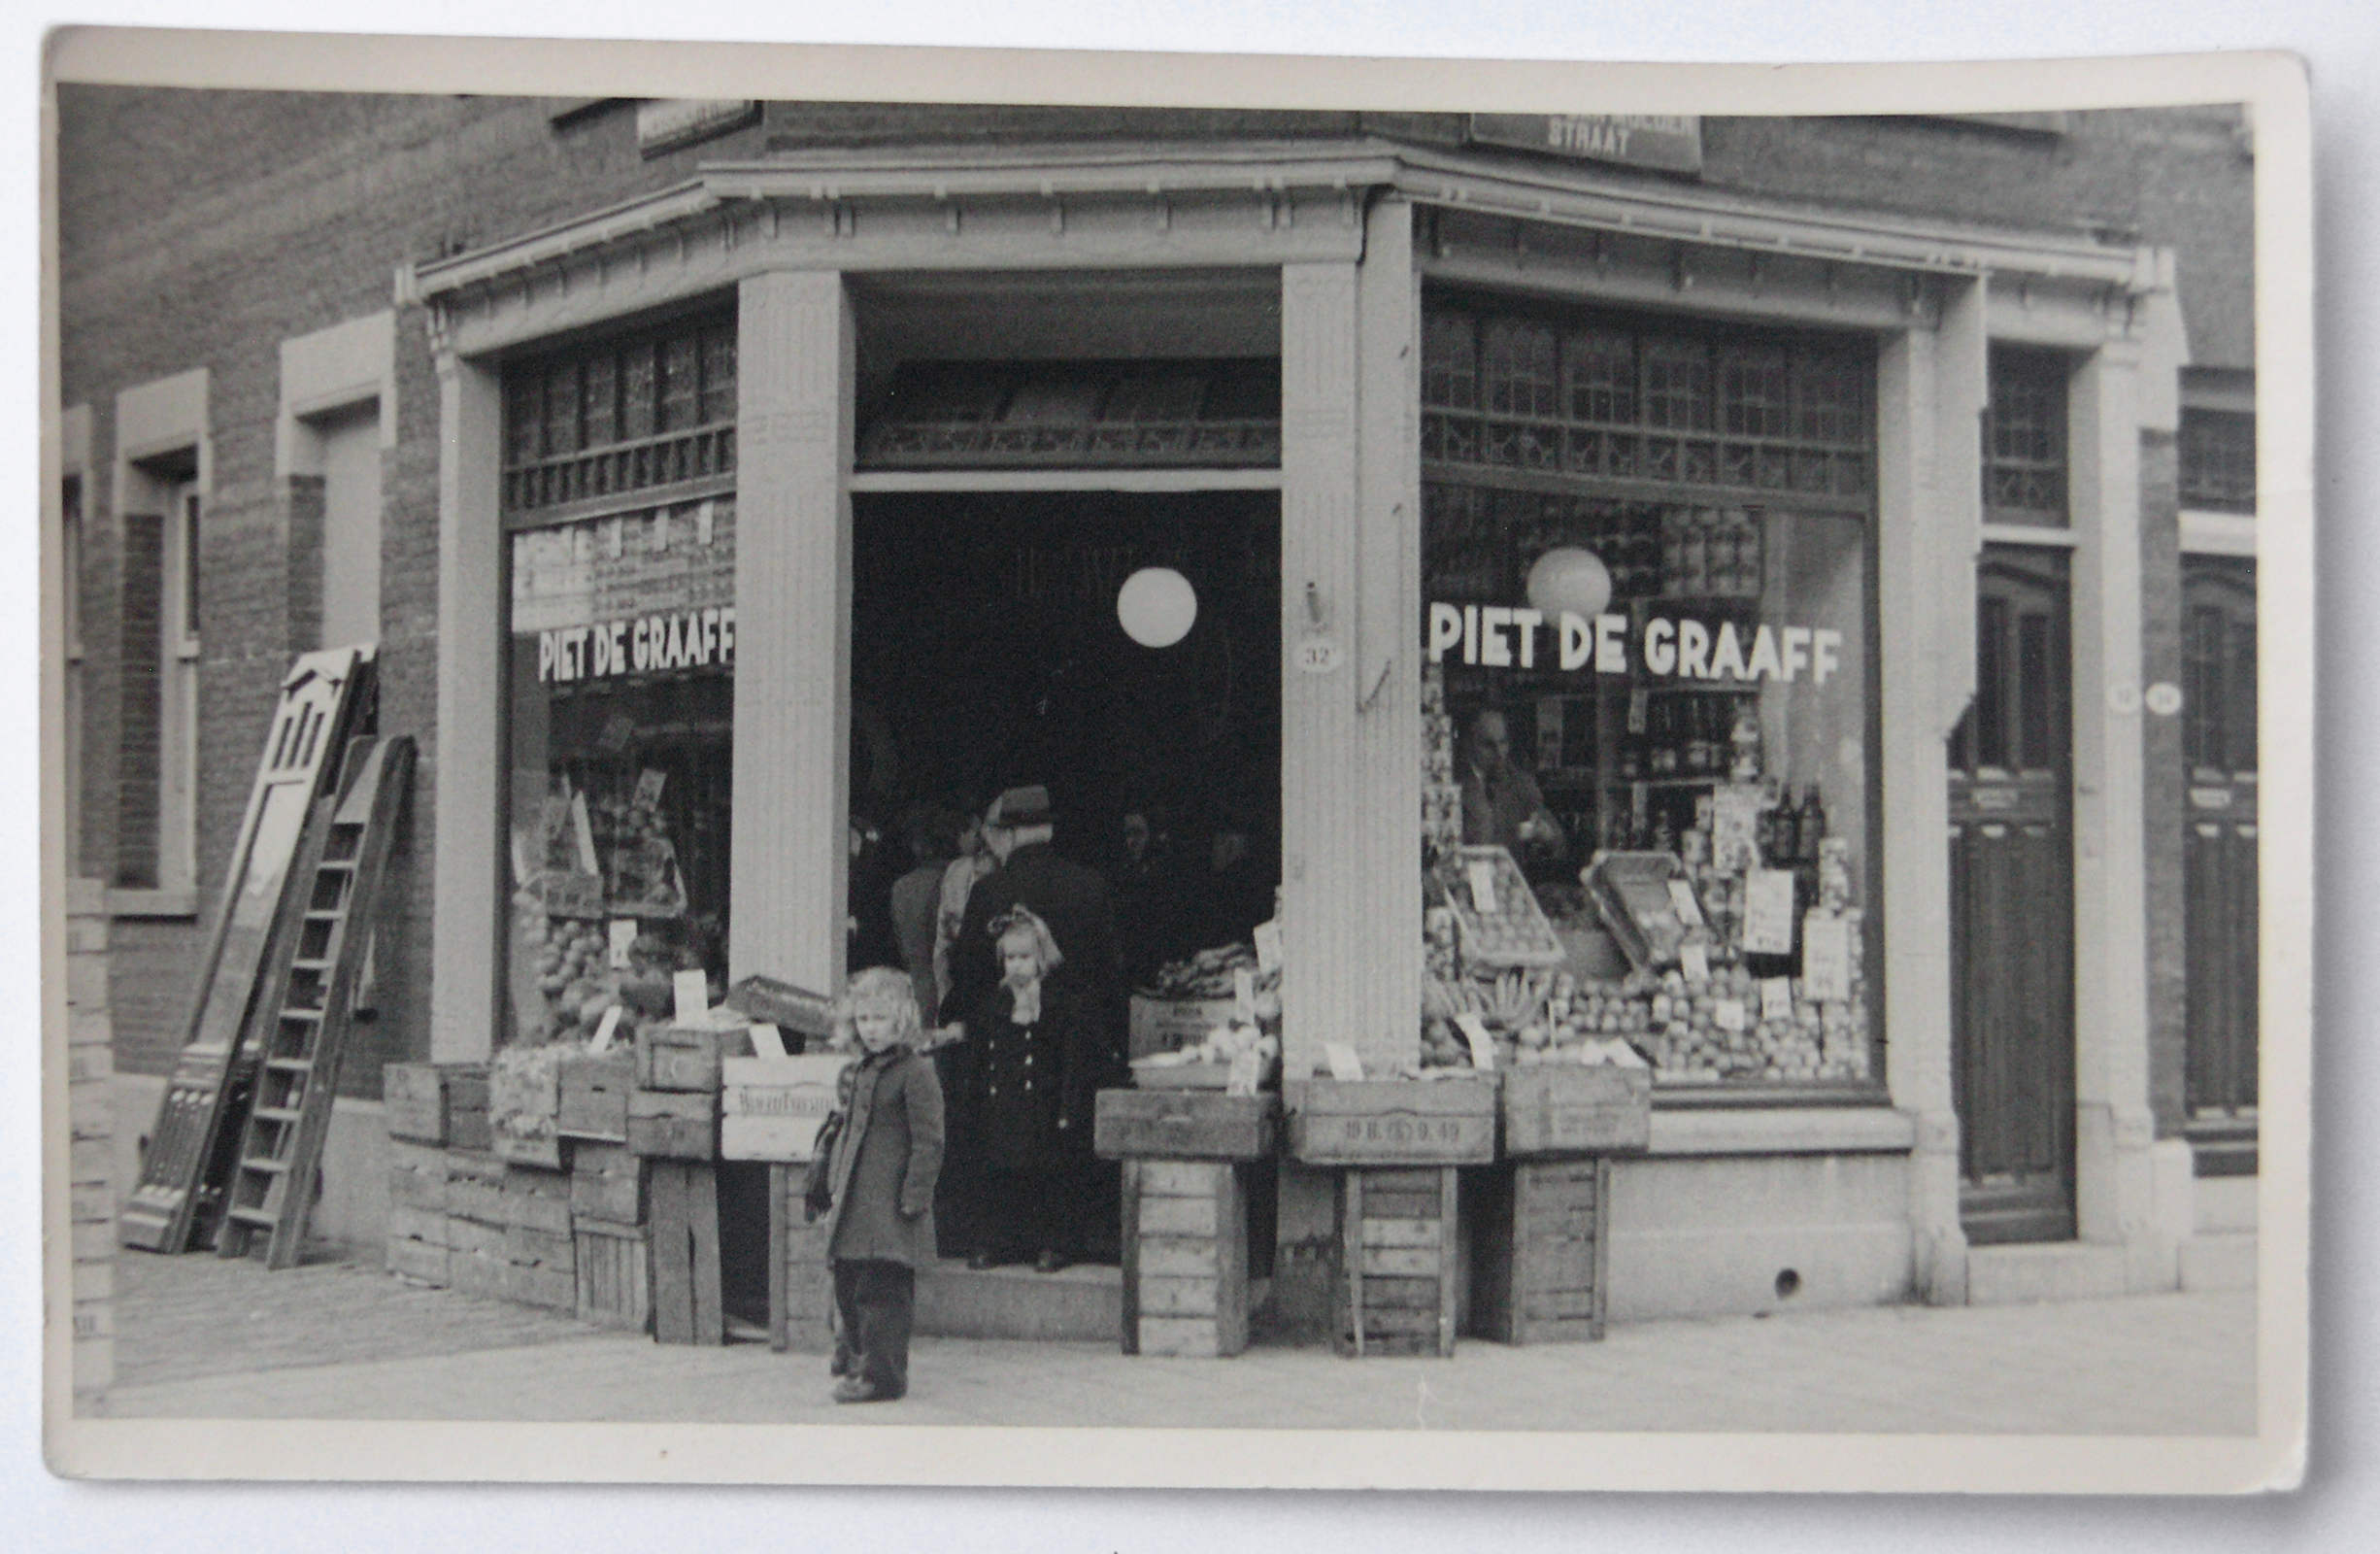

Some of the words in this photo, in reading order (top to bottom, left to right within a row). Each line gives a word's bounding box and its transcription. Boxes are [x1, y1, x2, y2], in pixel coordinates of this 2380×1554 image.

[1548, 116, 1630, 156] STRAAT
[539, 626, 587, 682] PIET
[594, 621, 626, 677] DE
[633, 607, 735, 670] GRAAFF
[1428, 601, 1542, 668] PIET
[1559, 610, 1627, 673] DE
[1644, 617, 1842, 685] GRAAFF
